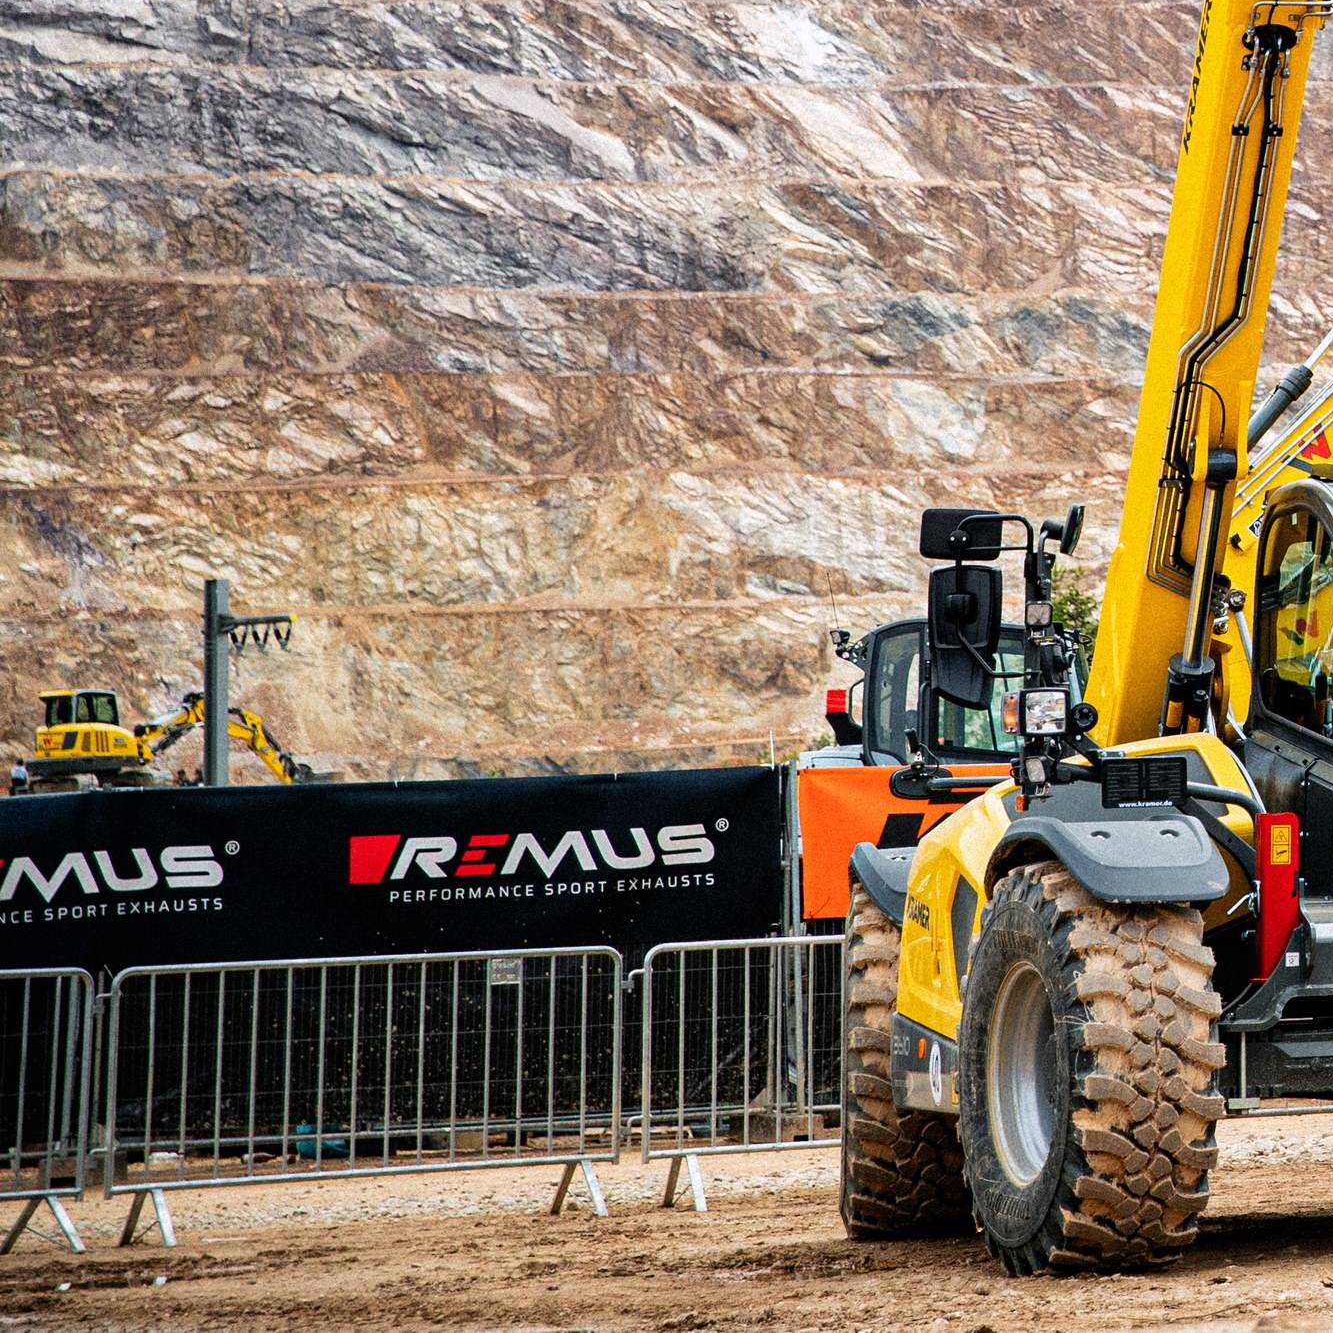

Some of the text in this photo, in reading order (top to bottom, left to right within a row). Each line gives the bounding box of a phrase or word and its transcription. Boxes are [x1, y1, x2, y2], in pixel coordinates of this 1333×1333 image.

[1118, 799, 1173, 808] www.kramer.de
[390, 823, 715, 880] REMUS
[0, 844, 224, 904] MUS
[390, 874, 715, 903] PERFORMANCE SPORT EXHAUSTS
[44, 904, 108, 922] SPORT
[117, 897, 224, 915] EXHAUSTS
